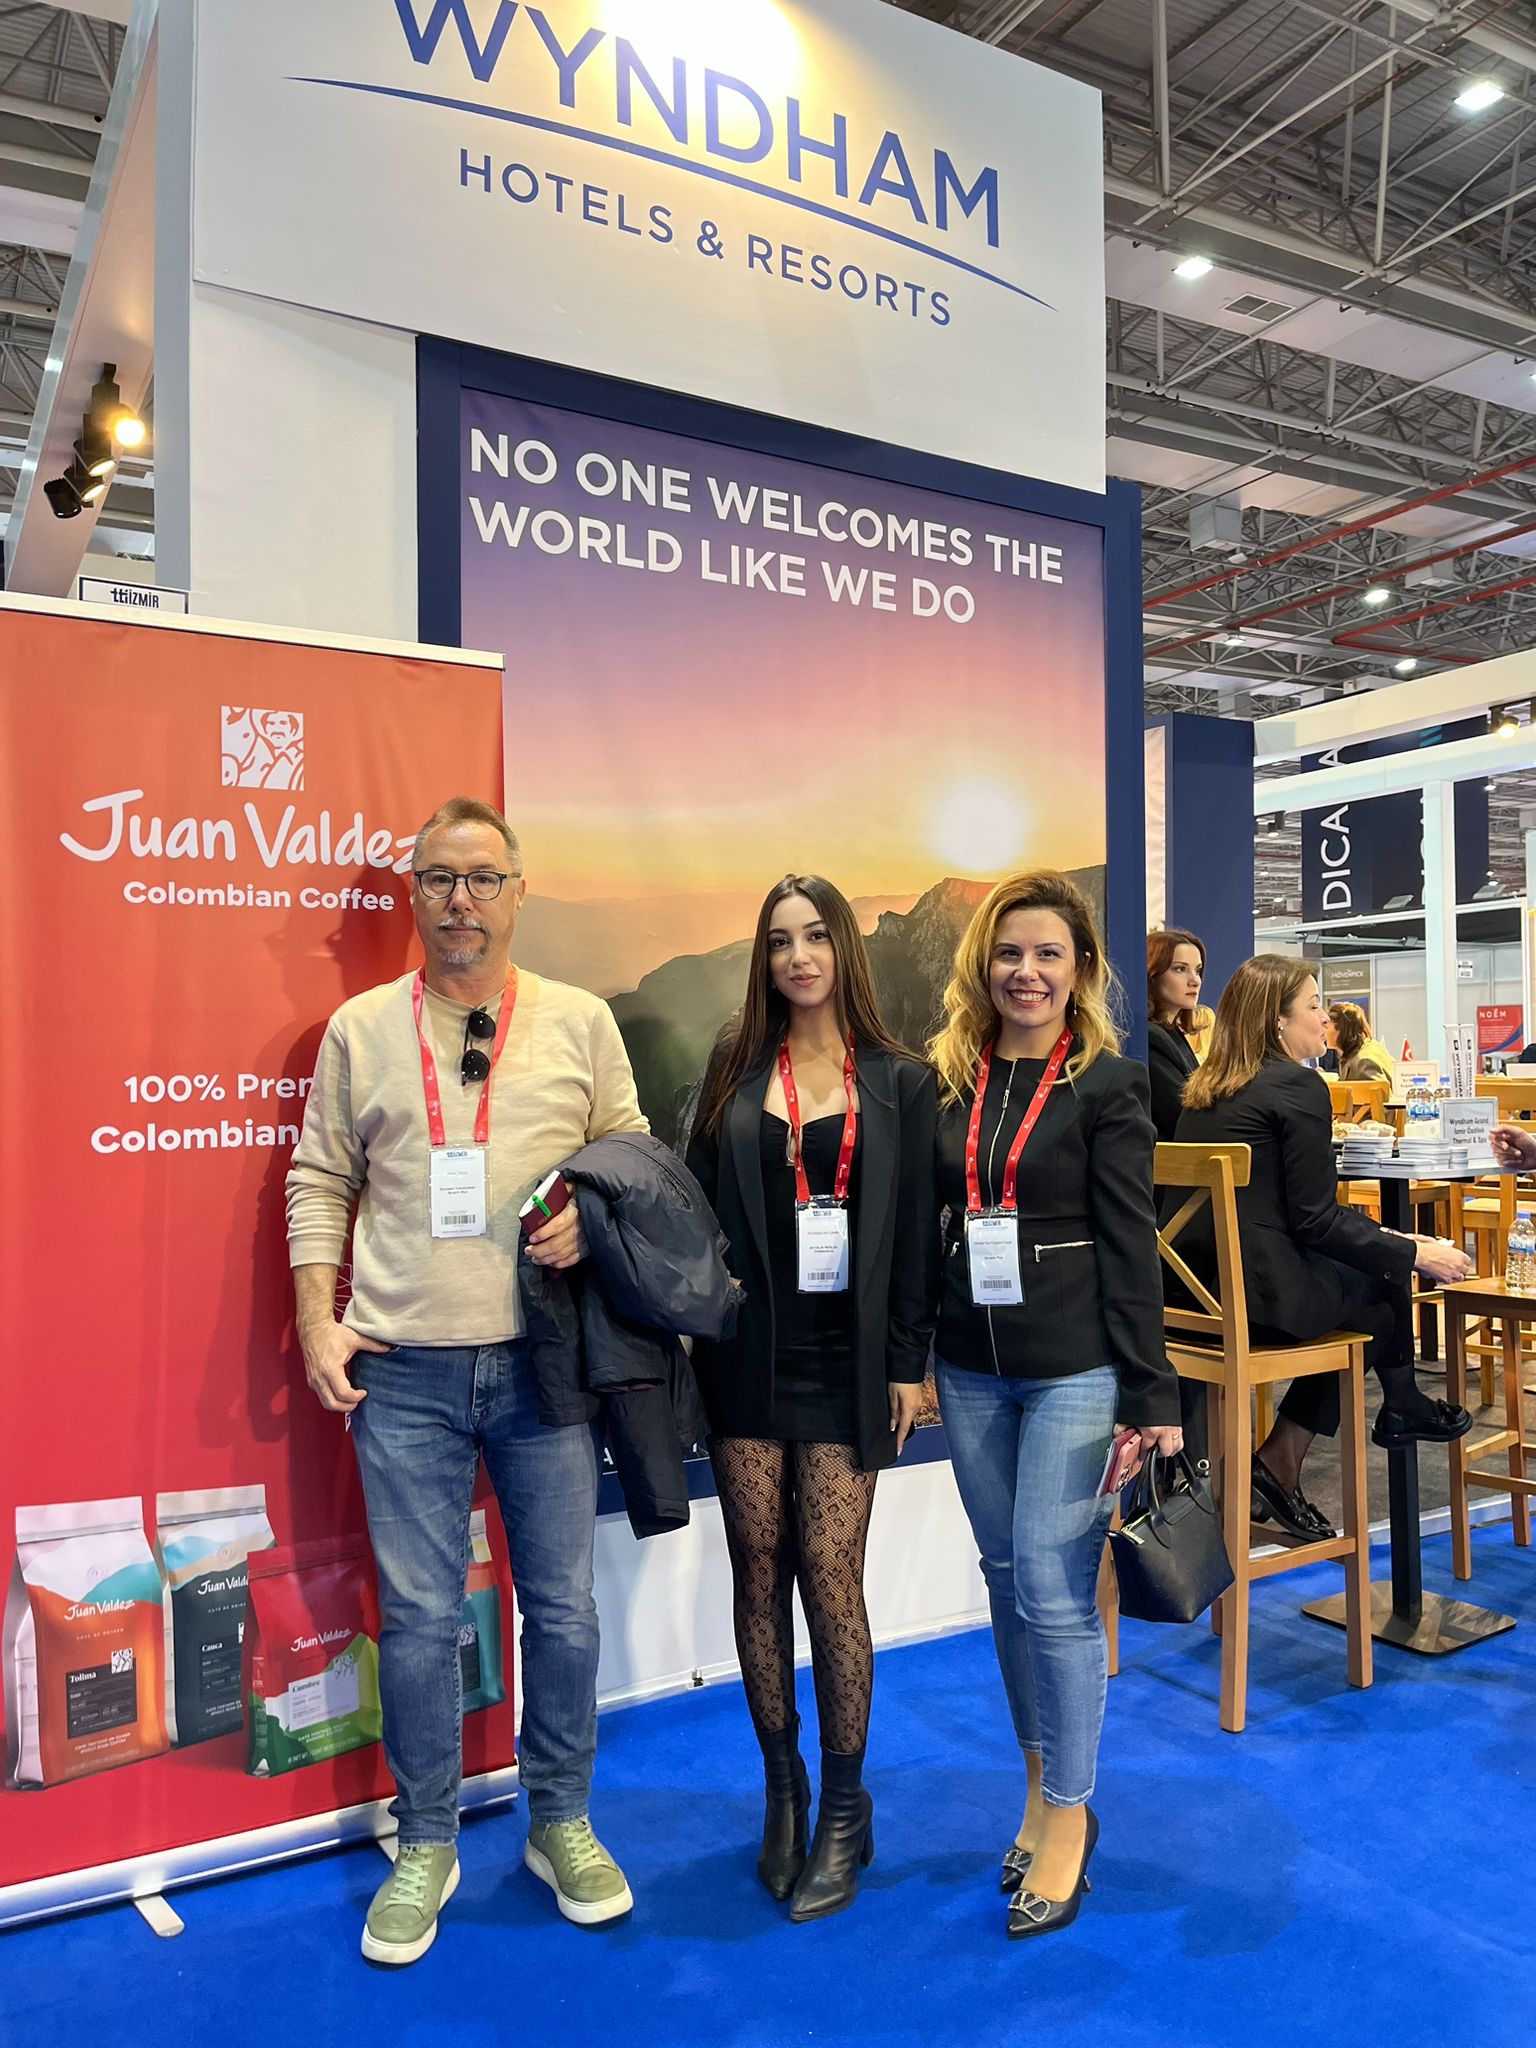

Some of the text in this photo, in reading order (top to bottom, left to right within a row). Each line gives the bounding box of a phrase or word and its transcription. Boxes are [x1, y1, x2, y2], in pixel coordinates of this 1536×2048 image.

[396, 0, 1000, 248] WYNDHAM
[459, 148, 952, 327] HOTELS & RESORTS
[470, 428, 1064, 585] NO ONE WELCOMES THE
[468, 496, 976, 625] WORLD LIKE WE DO
[60, 789, 236, 862] Juan
[123, 881, 395, 911] Colombian Coffee
[124, 1074, 226, 1103] 100%
[90, 1118, 300, 1154] Colombian
[196, 1575, 249, 1595] Juan Vald
[64, 1599, 136, 1621] Juan Valdez
[202, 1641, 223, 1653] Cauca
[291, 1628, 351, 1652] Juan Valdez
[69, 1671, 97, 1684] Tolima
[292, 1679, 321, 1694] Cumbre
